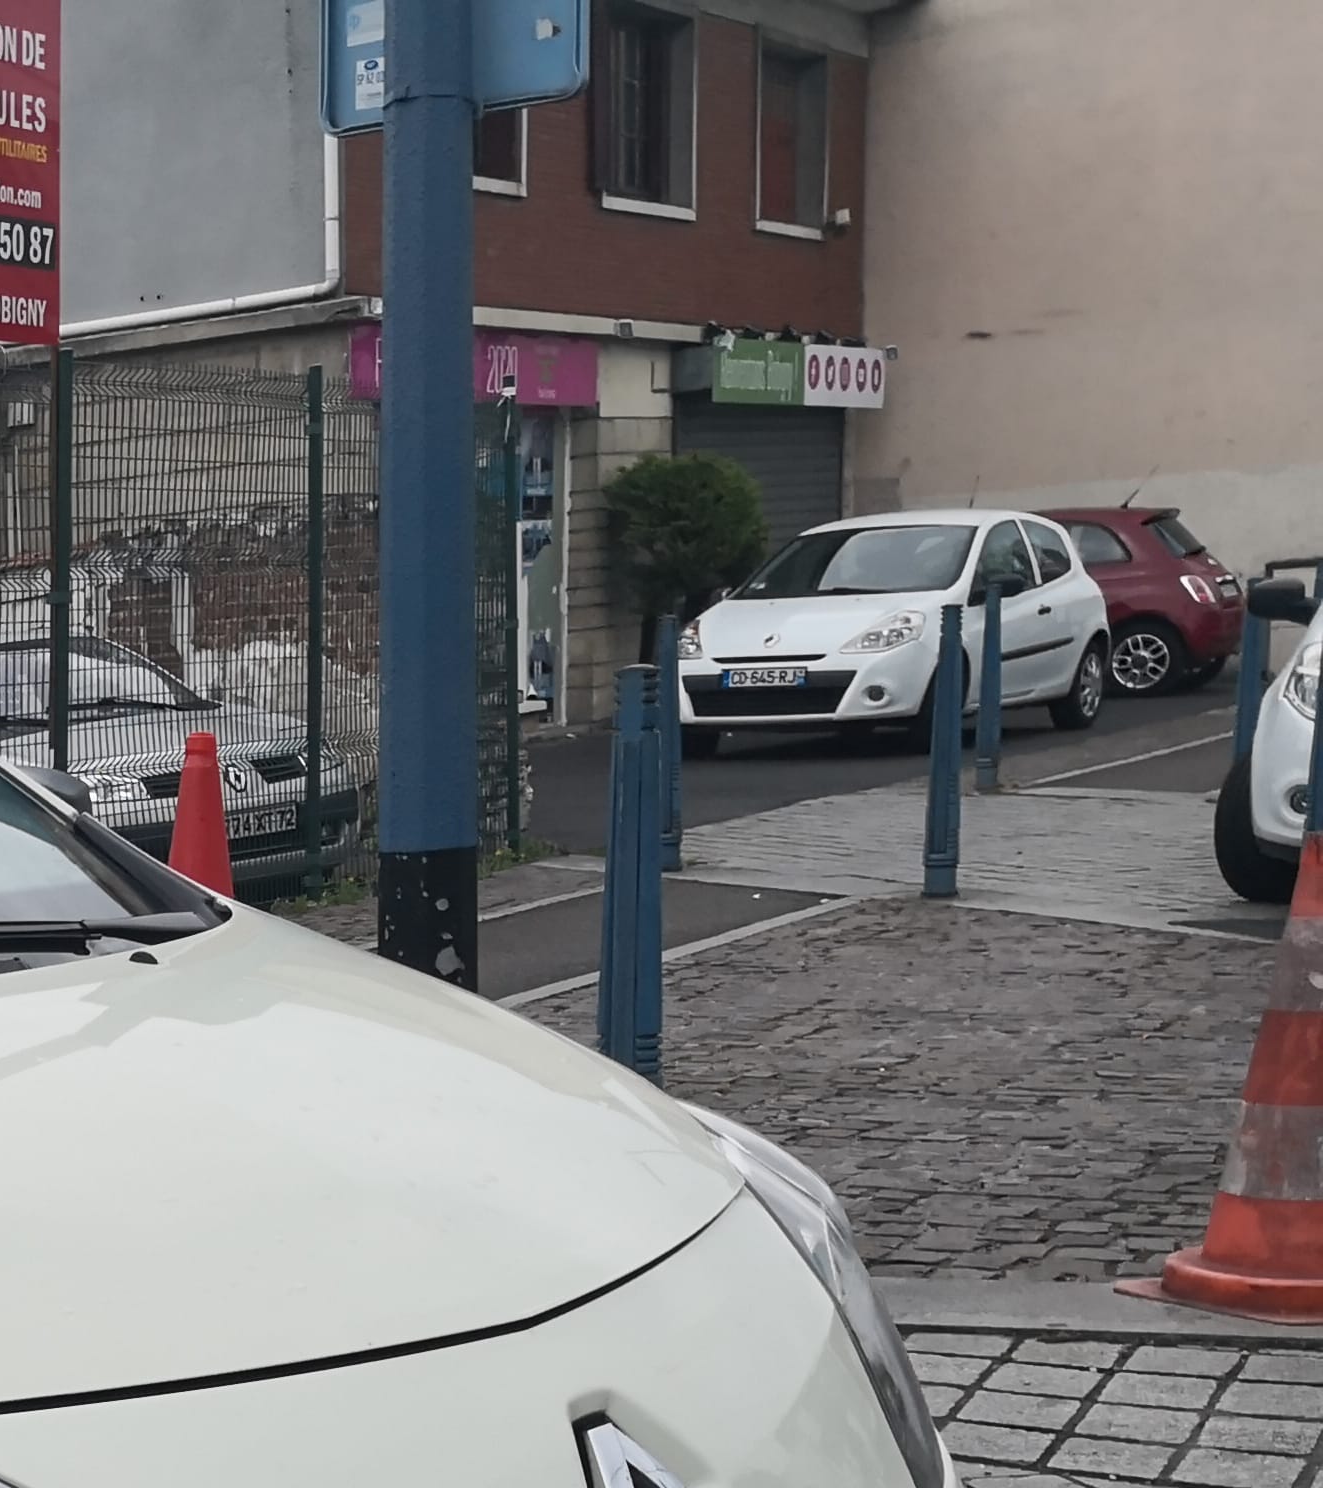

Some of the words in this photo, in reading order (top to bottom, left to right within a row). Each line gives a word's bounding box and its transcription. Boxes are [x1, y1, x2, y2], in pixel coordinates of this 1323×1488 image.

[22, 28, 47, 70] DE
[0, 222, 25, 263] 50
[30, 226, 54, 265] 87
